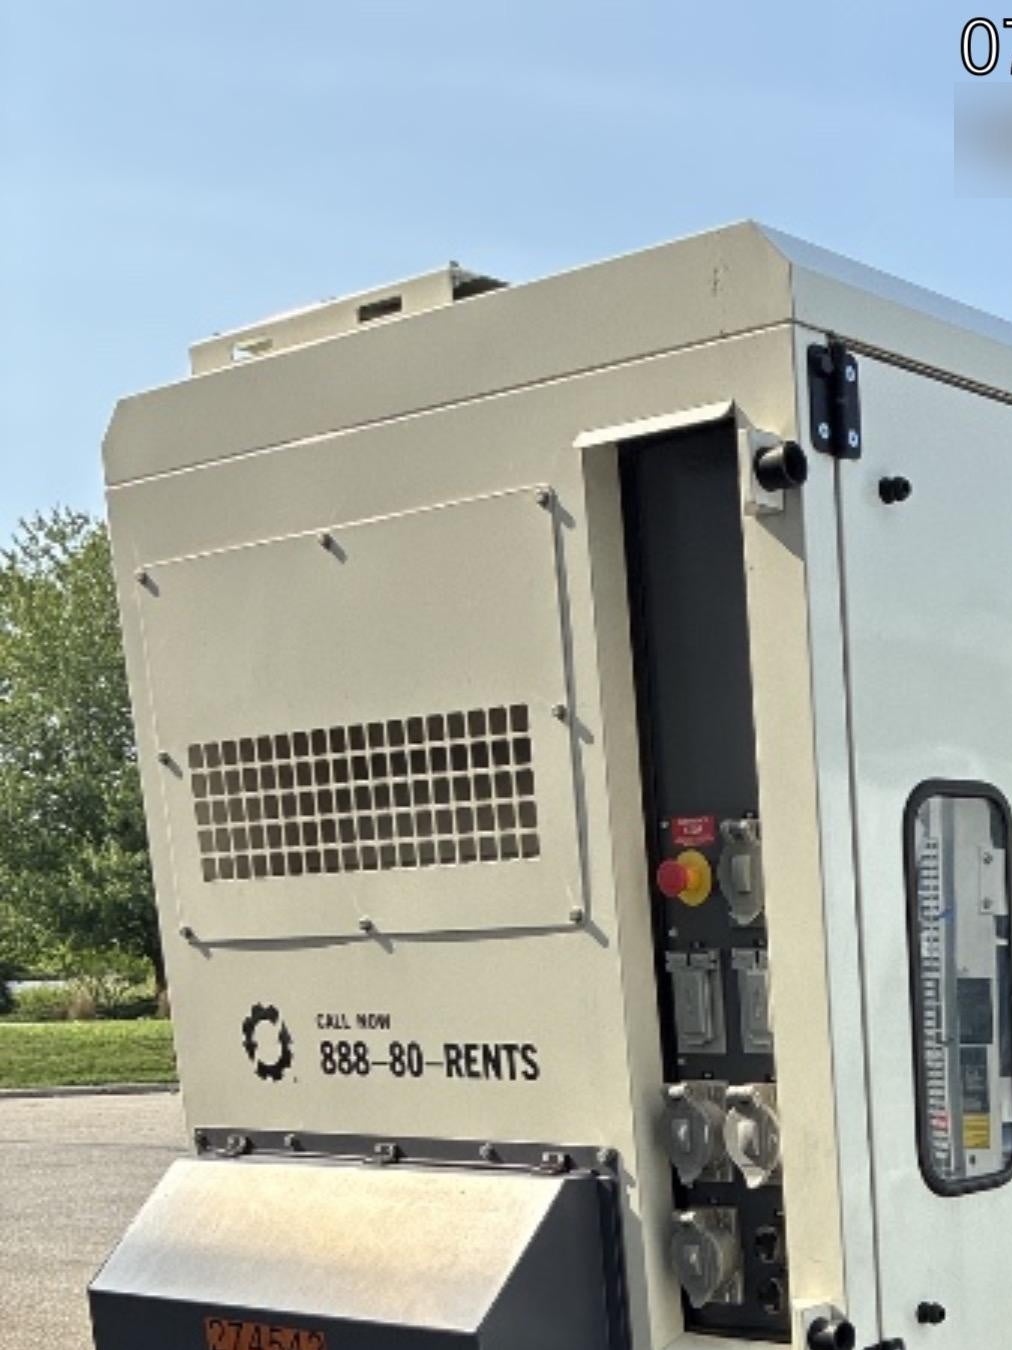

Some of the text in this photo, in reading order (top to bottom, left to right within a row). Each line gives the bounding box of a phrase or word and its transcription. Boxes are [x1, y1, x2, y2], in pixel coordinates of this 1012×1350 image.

[316, 1013, 391, 1030] CALL NOW
[320, 1040, 541, 1081] 888-80-RENTS
